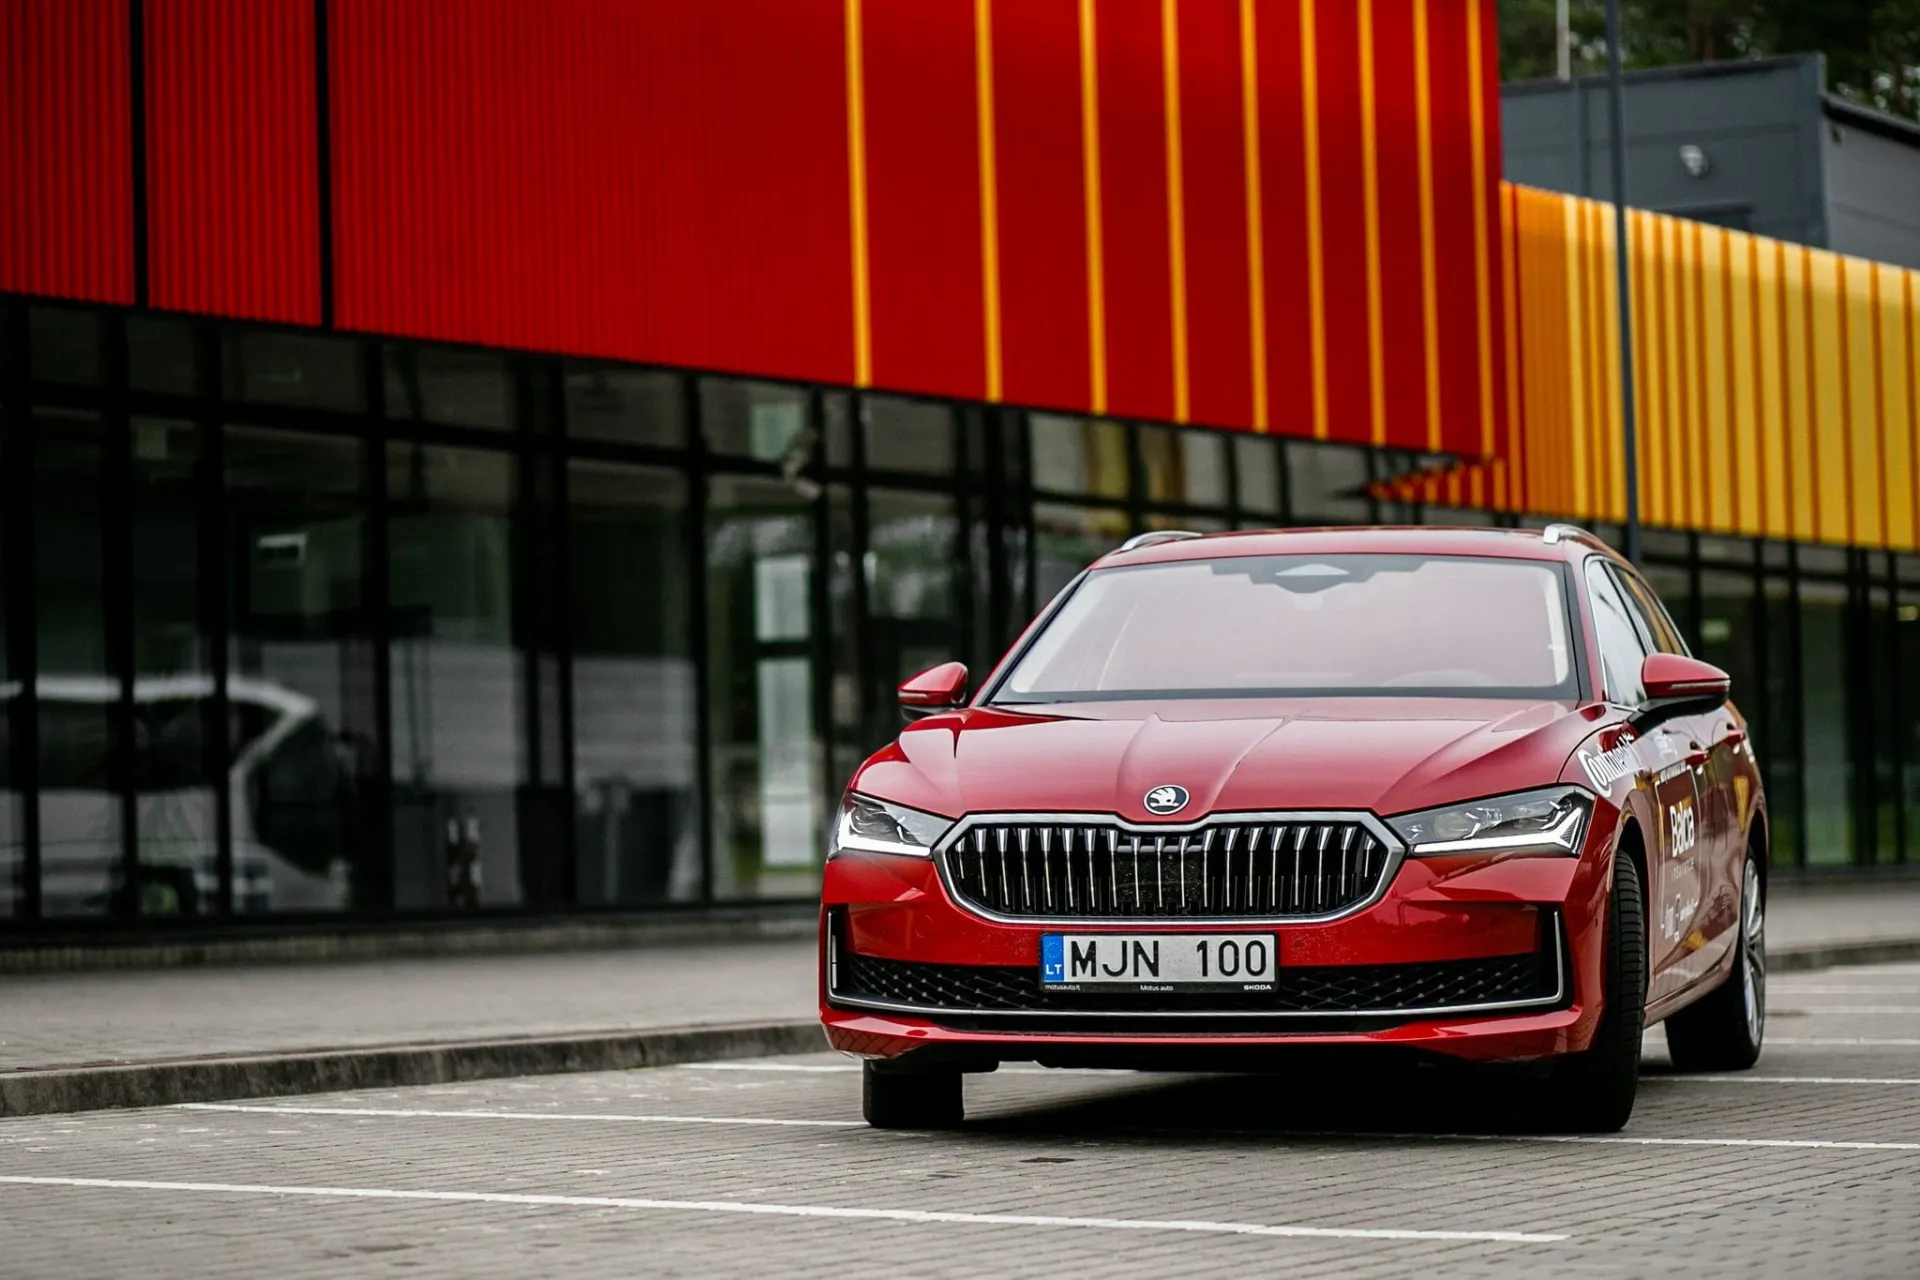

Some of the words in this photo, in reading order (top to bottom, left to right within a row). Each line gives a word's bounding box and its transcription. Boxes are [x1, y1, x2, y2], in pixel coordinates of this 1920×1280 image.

[1045, 964, 1063, 975] LT
[1071, 940, 1160, 977] MJN
[1196, 940, 1266, 977] 100
